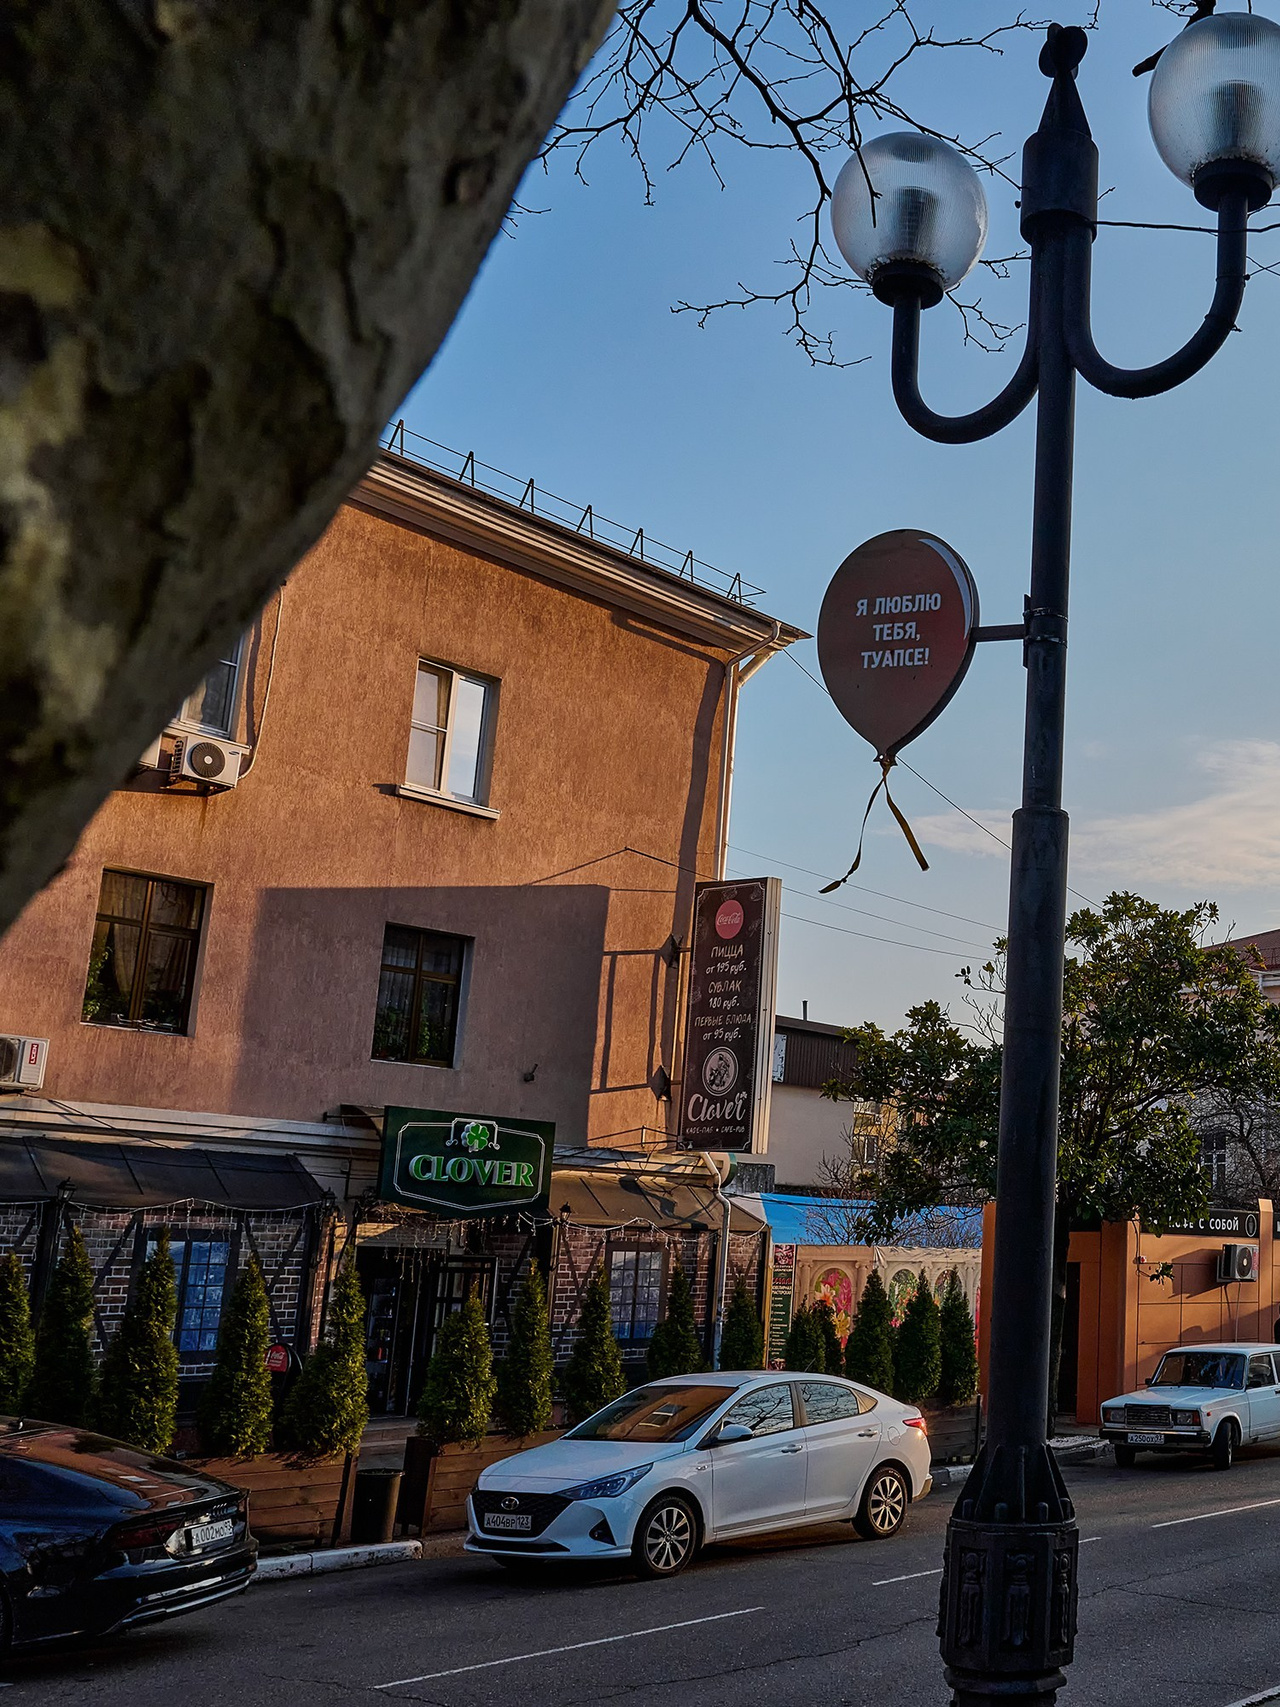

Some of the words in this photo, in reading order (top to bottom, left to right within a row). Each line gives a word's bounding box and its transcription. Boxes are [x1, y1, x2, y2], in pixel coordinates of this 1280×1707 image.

[855, 597, 868, 617] Я
[873, 592, 942, 615] ЛЮБЛЮ
[873, 621, 921, 642] ТЕБЯ,
[861, 647, 930, 669] ТУАПСЕ!
[710, 944, 745, 959] ПИЦЦА
[705, 965, 715, 975] от
[716, 960, 730, 973] 195
[729, 960, 748, 975] руб.
[708, 997, 722, 1009] 180
[722, 995, 740, 1011] руб.
[694, 1013, 723, 1027] ПЕРВЫЕ
[725, 1012, 752, 1026] БЛЮДА
[702, 1031, 713, 1041] от
[713, 1028, 724, 1040] 95
[724, 1027, 742, 1043] руб.
[687, 1093, 747, 1122] Clover
[408, 1154, 535, 1188] CLOVER
[1209, 1216, 1240, 1231] СОБОЙ
[486, 1515, 516, 1528] А404ВР
[516, 1515, 530, 1526] 123
